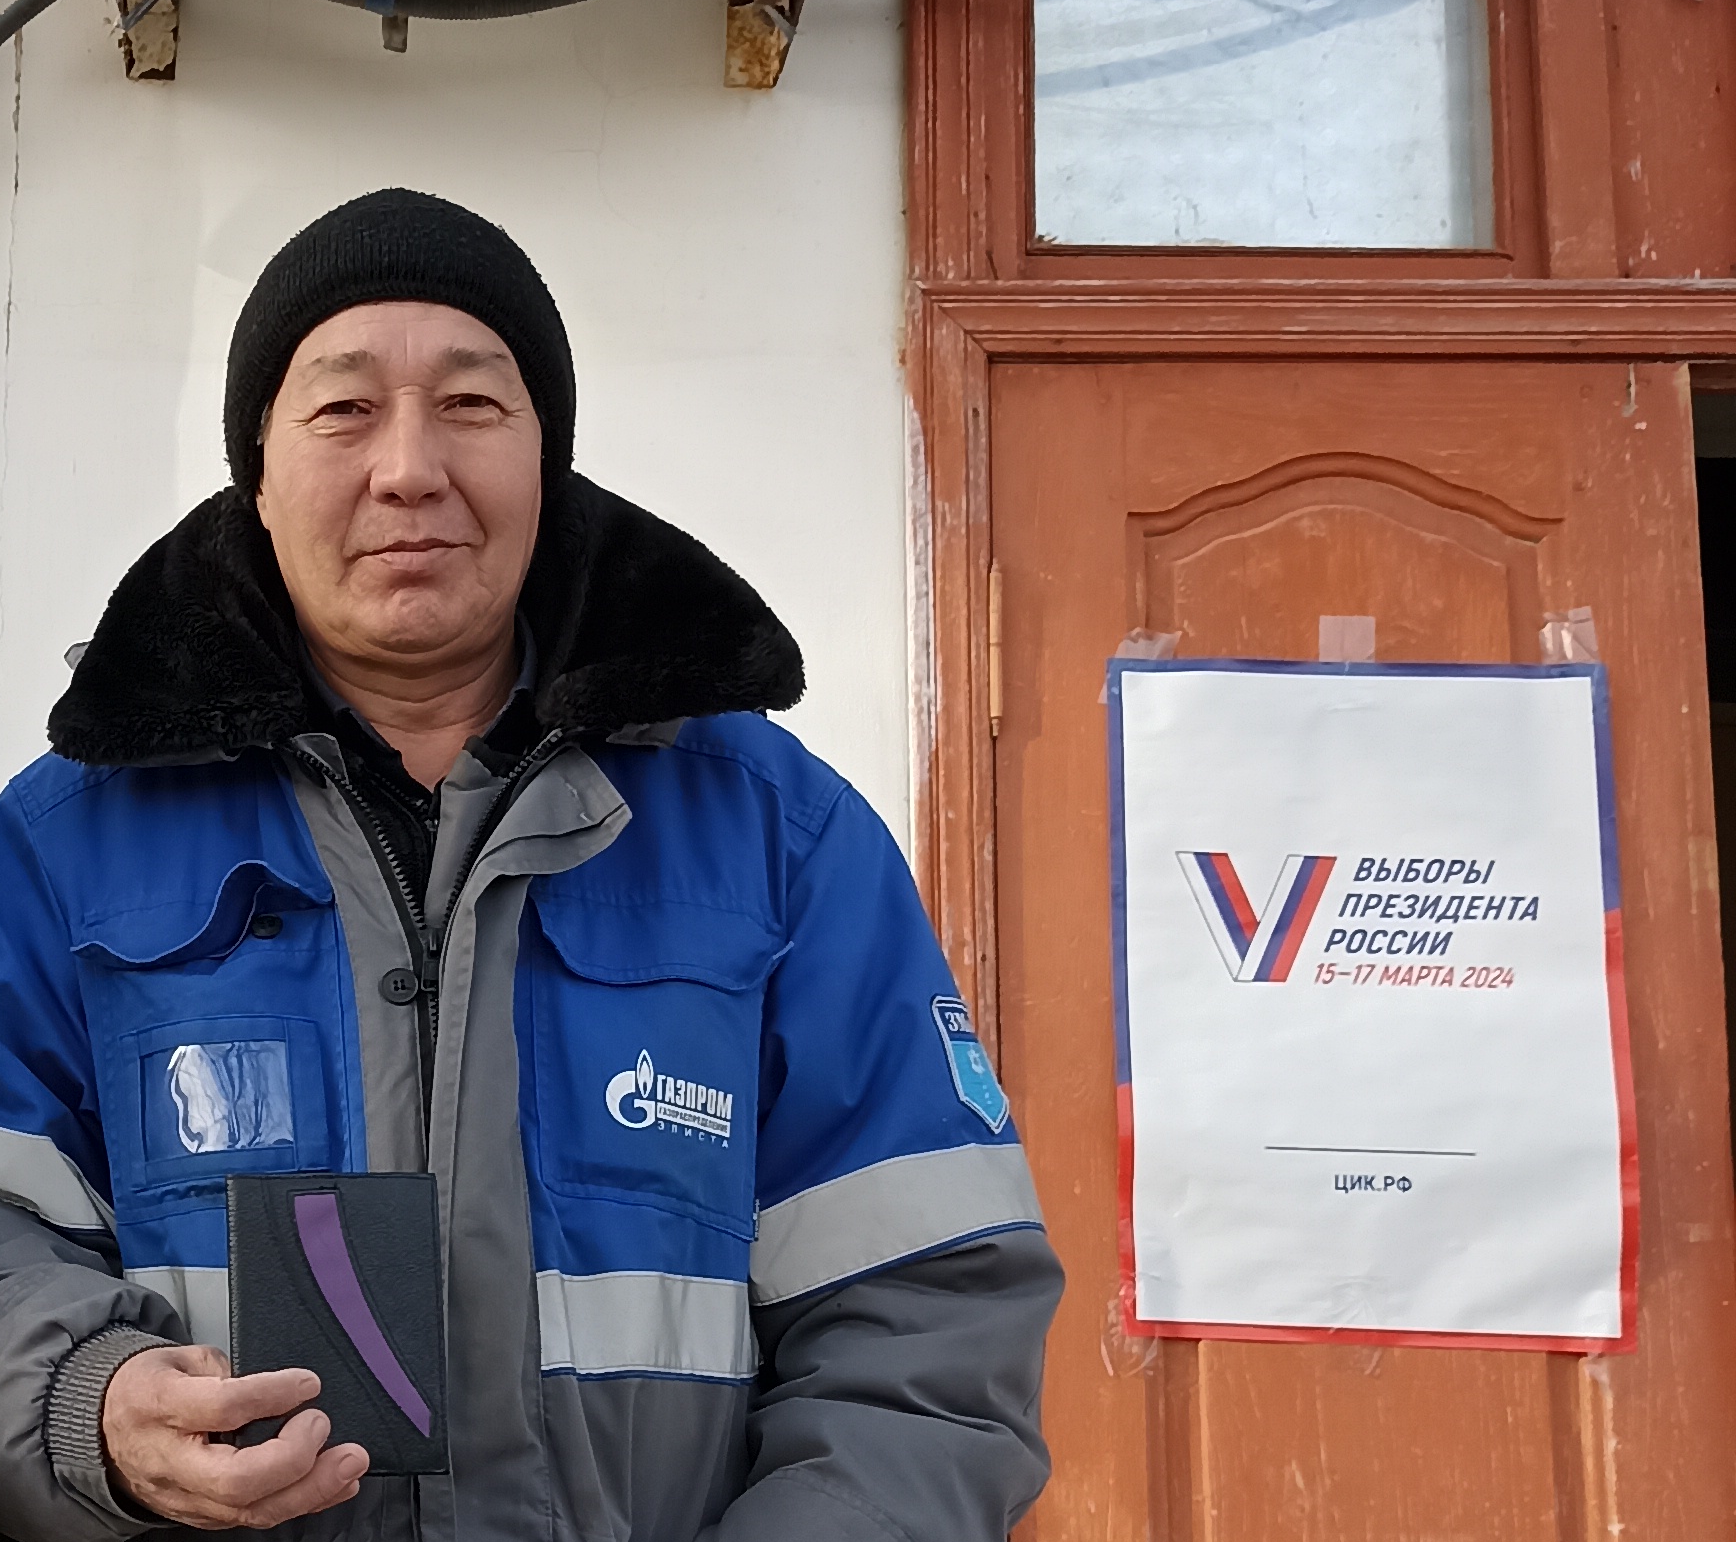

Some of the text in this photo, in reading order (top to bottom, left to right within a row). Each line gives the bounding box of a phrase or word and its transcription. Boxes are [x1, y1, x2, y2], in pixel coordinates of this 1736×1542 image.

[1353, 857, 1496, 885] ВЫБОРЫ
[1337, 892, 1540, 924] ПРЕЗИДЕНТА
[1323, 928, 1454, 957] РОССИИ
[1377, 964, 1456, 988] МАРТА
[1459, 965, 1515, 990] 2024
[656, 1073, 733, 1121] ГАЗПРОМ
[1334, 1173, 1413, 1194] ЦИК.РФ
